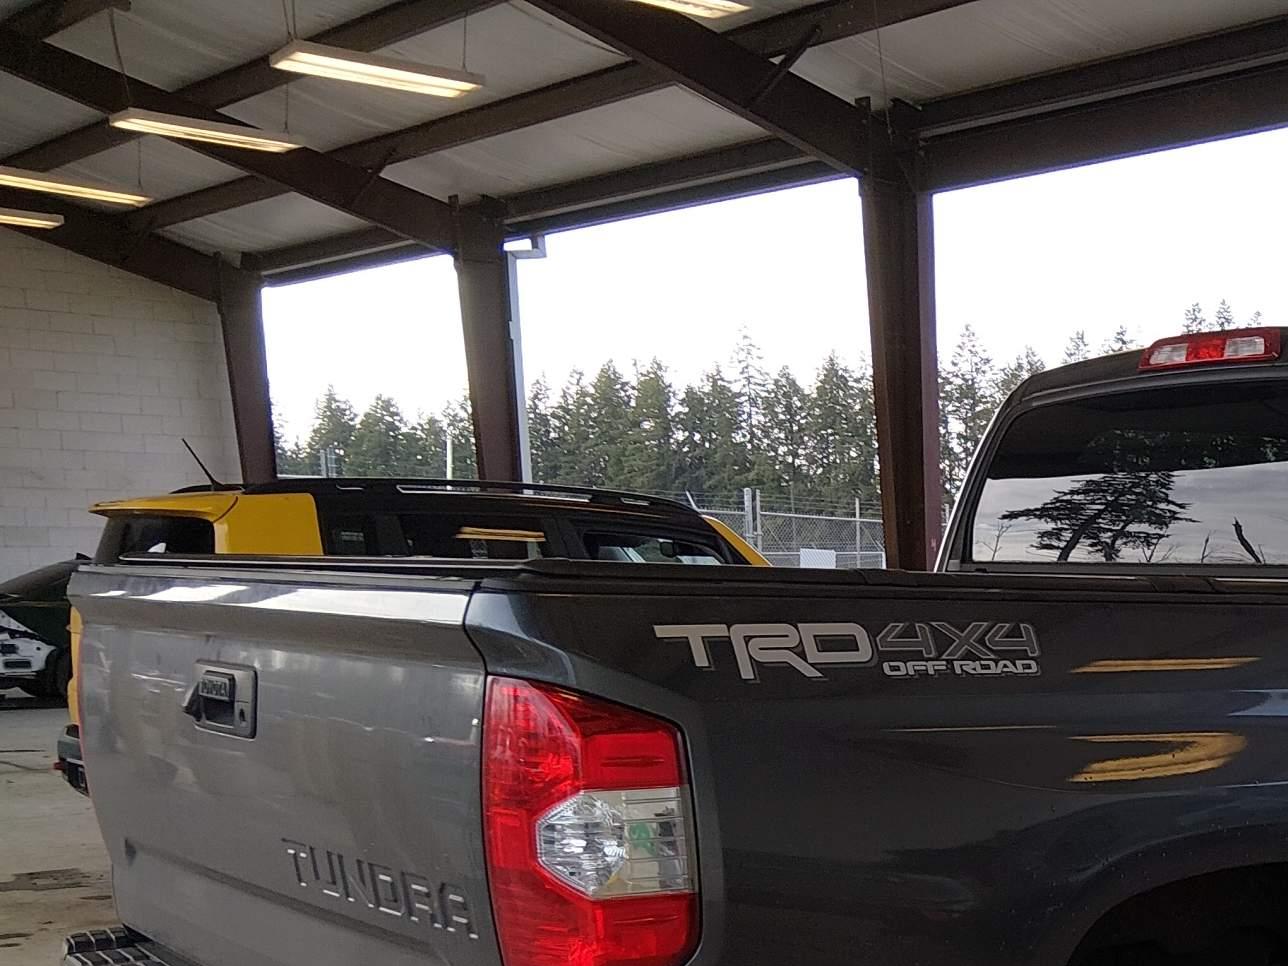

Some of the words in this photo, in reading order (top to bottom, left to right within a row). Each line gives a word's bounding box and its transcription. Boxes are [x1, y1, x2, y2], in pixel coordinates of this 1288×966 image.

[652, 621, 875, 682] TRD
[876, 620, 1041, 660] 4X4
[882, 660, 950, 677] OFF
[952, 658, 1040, 676] ROAD
[281, 837, 480, 940] TUNDRA
